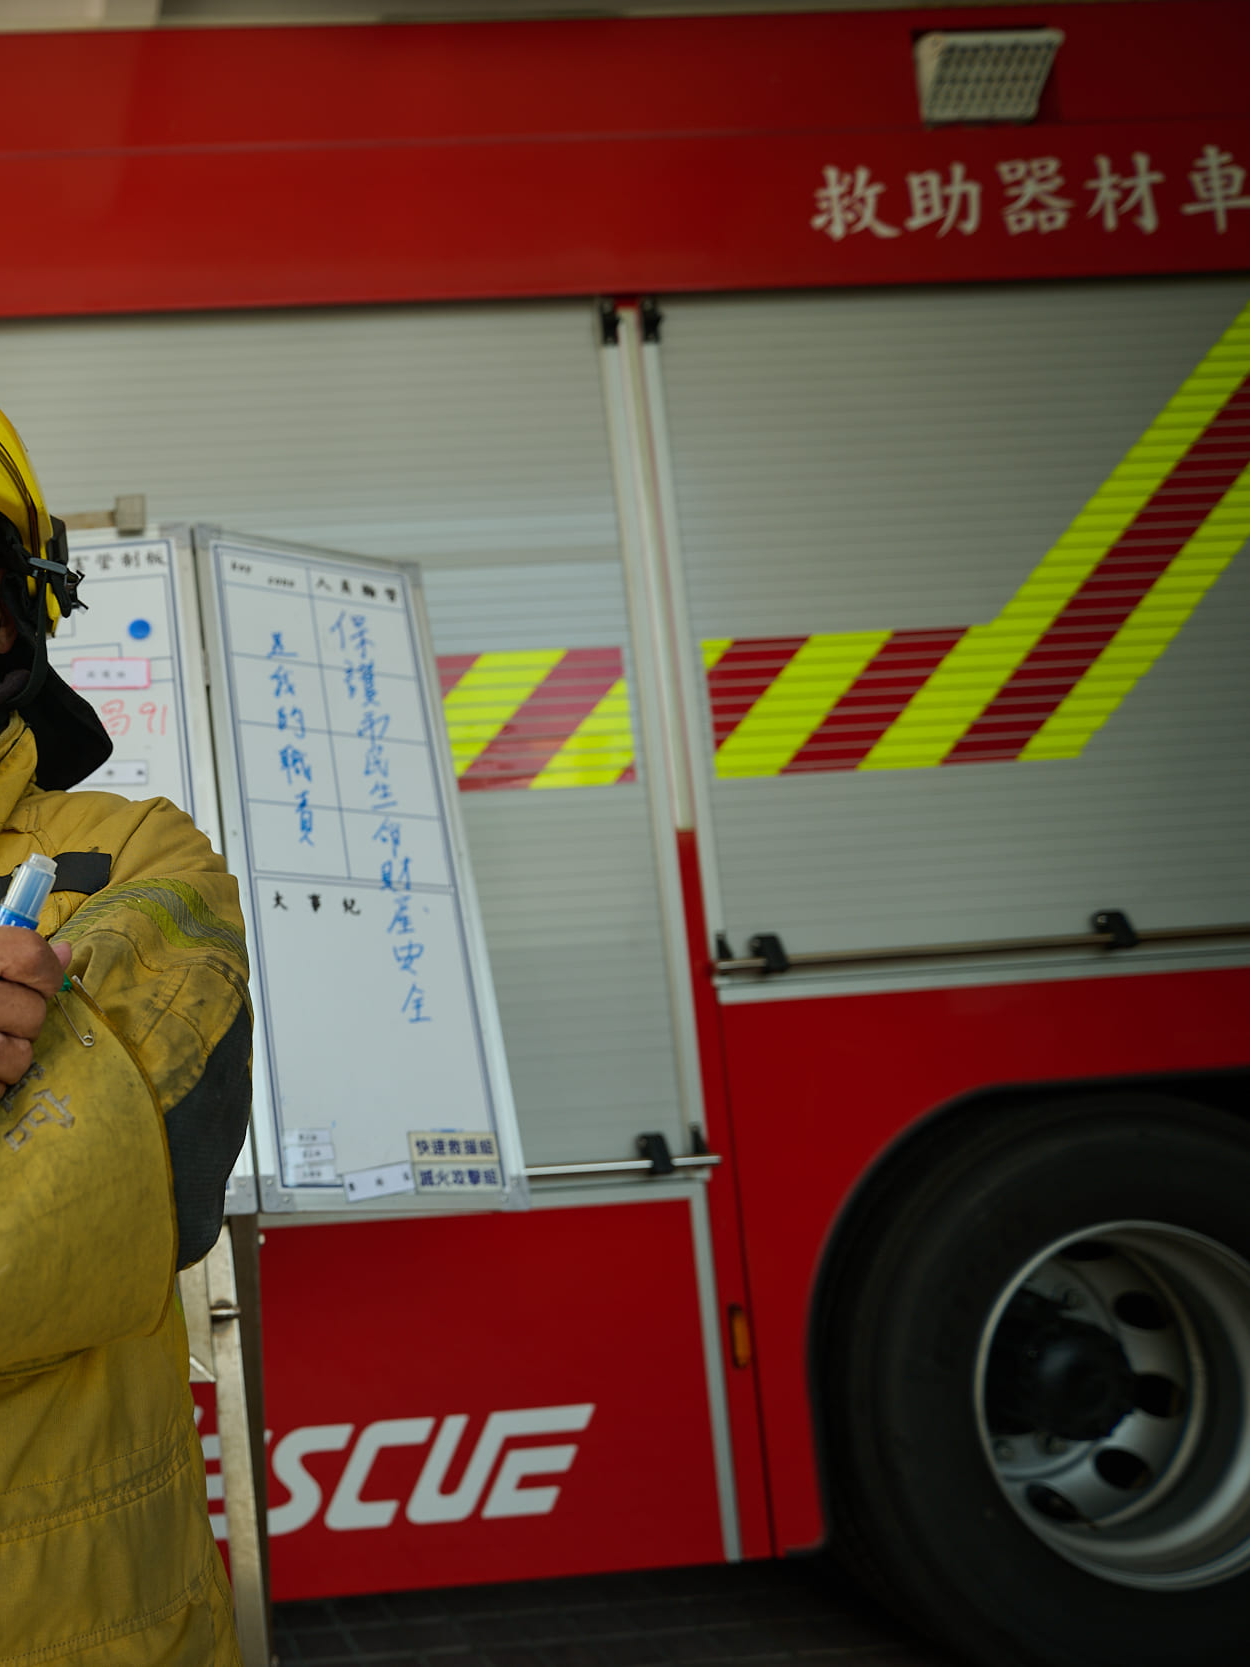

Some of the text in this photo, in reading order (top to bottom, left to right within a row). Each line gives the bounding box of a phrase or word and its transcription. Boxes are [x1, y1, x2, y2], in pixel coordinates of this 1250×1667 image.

[811, 144, 1250, 241] 救助器材車
[193, 1403, 595, 1540] SCUE
